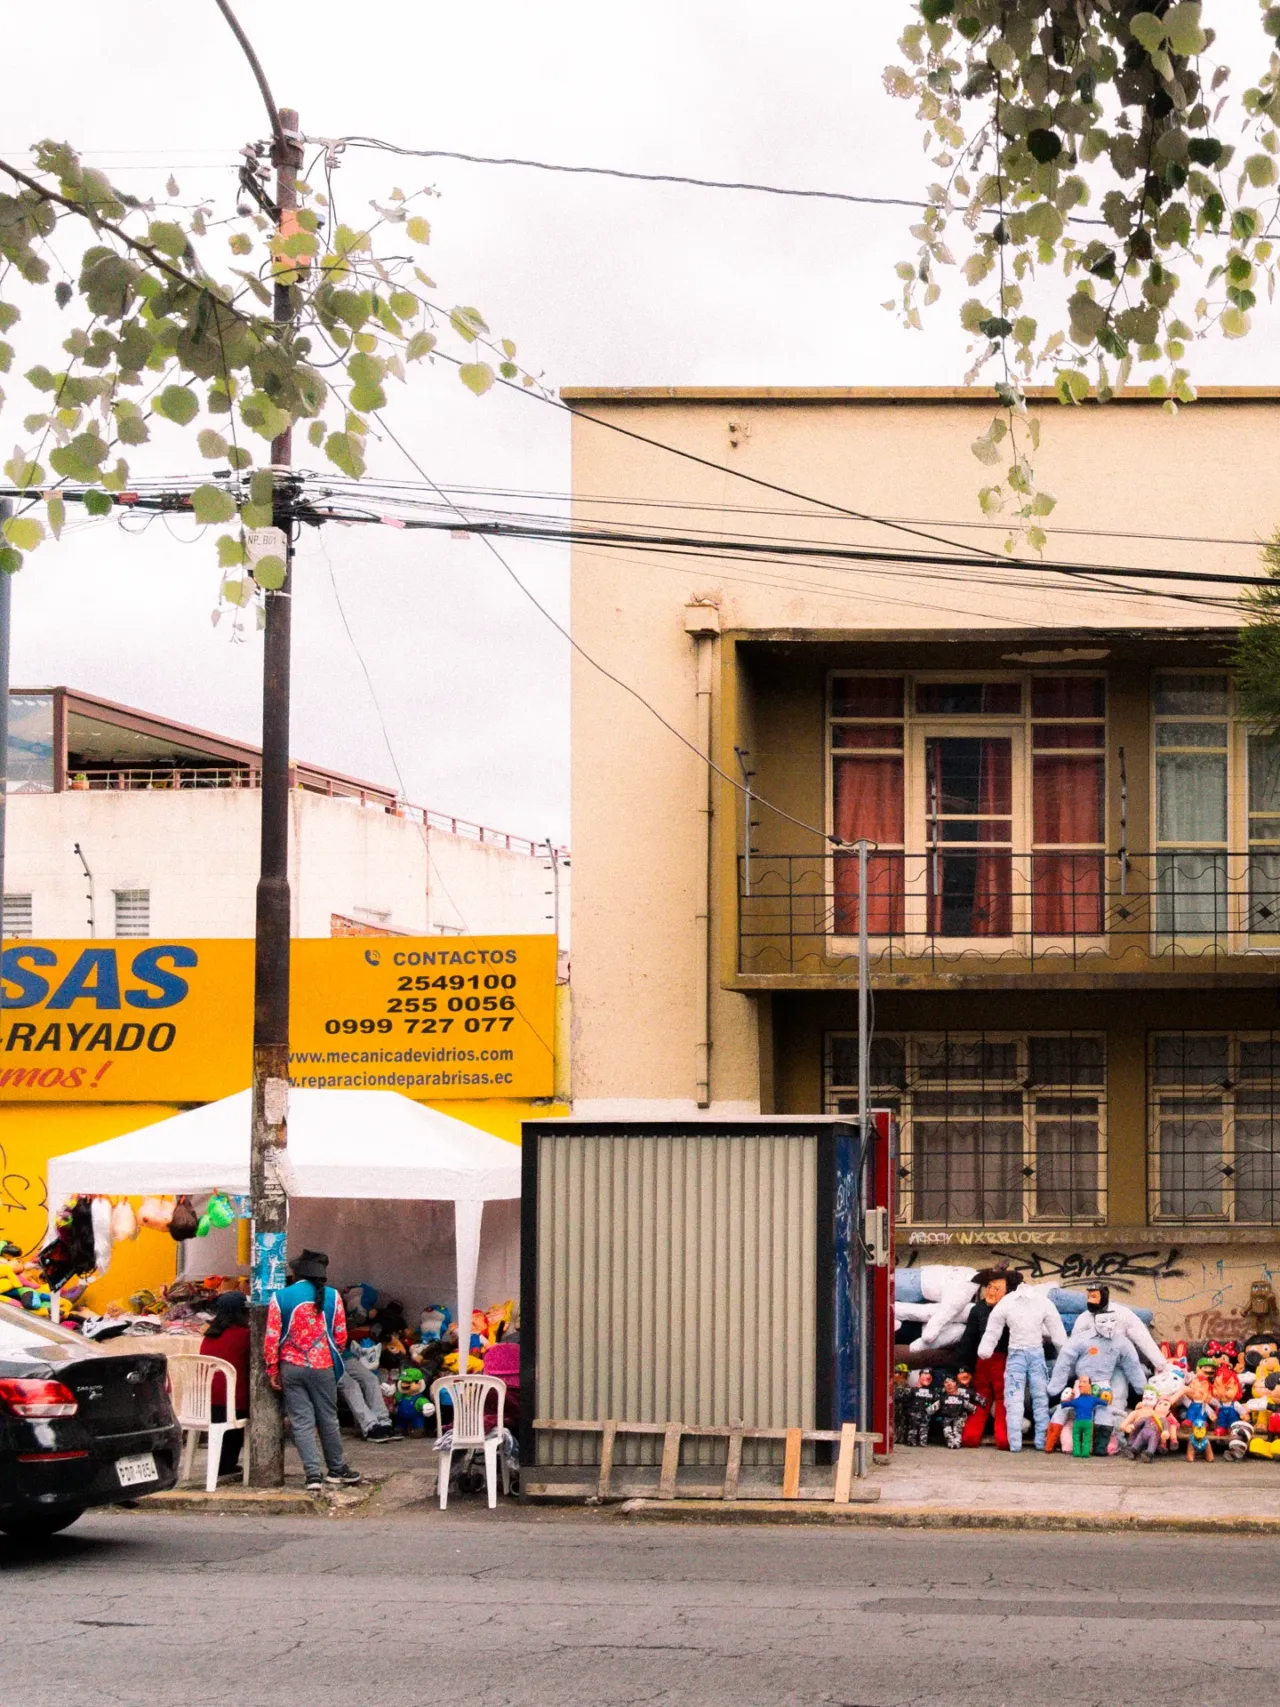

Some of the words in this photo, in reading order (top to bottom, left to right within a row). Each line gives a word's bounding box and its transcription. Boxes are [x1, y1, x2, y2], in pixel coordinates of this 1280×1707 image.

[393, 949, 518, 966] CONTACTOS
[397, 974, 517, 991] 2549100
[386, 998, 437, 1013] 255
[447, 996, 516, 1012] 0056
[325, 1018, 393, 1034] 0999
[403, 1019, 454, 1034] 727
[464, 1017, 515, 1033] 077
